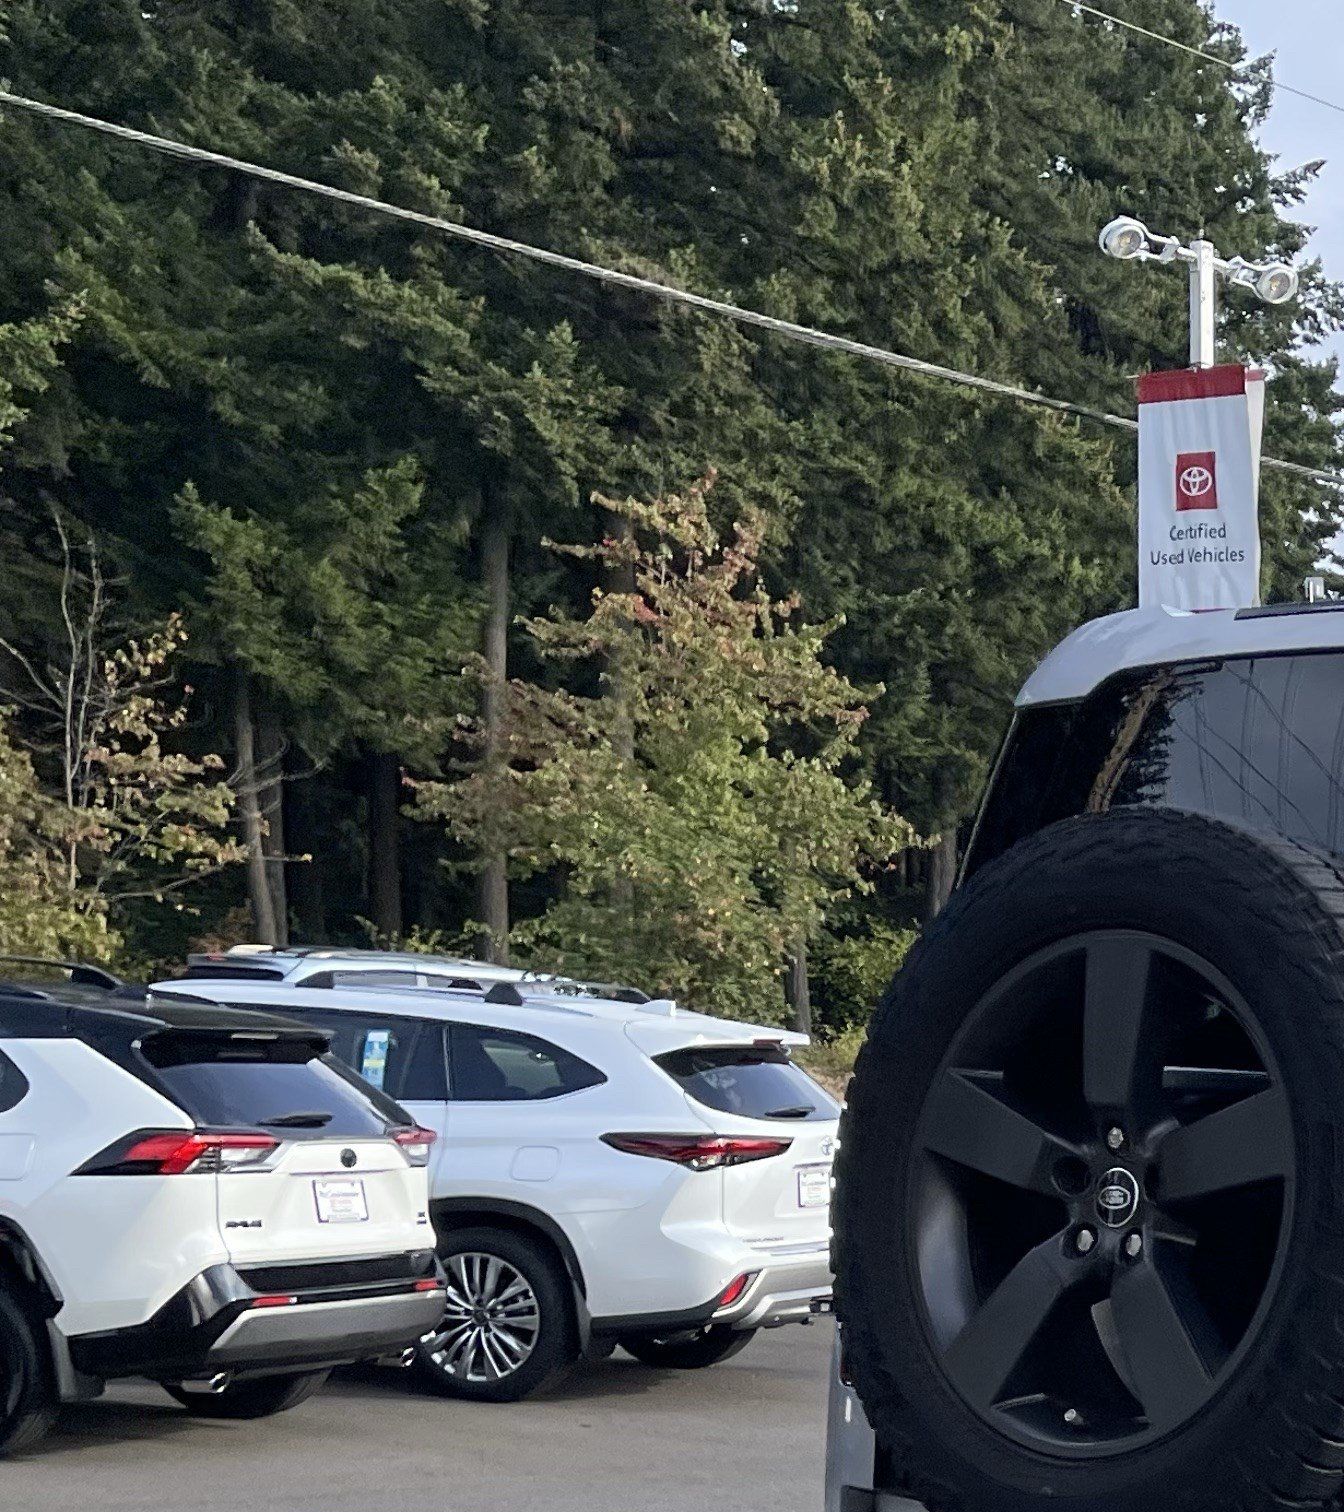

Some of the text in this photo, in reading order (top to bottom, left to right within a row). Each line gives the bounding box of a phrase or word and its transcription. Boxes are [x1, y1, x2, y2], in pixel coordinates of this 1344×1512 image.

[1169, 522, 1227, 541] Certified
[1150, 546, 1245, 565] Used Vehicles
